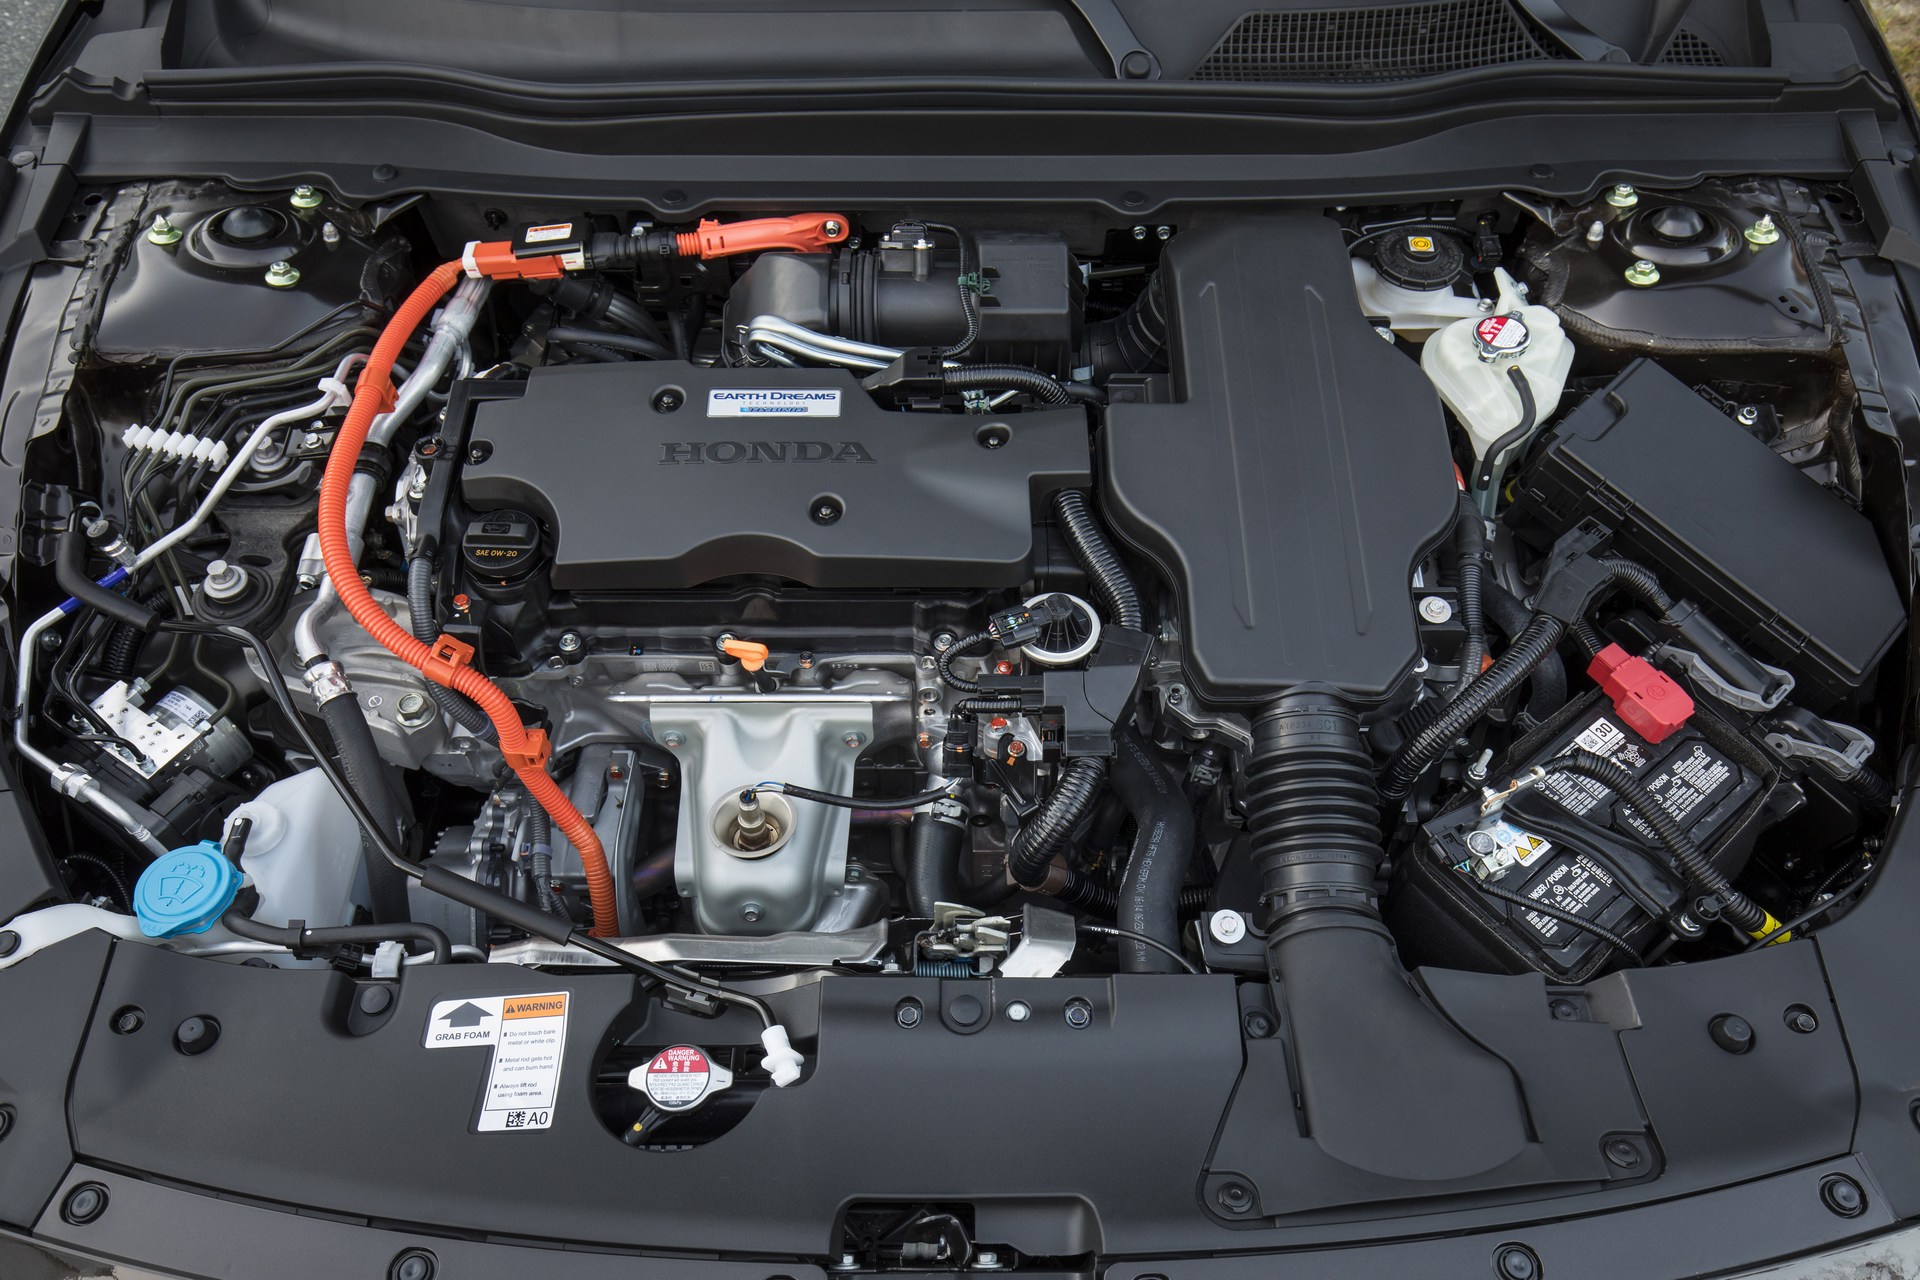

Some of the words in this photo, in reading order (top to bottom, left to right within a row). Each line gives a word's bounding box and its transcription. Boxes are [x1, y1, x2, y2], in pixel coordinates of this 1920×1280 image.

[713, 392, 767, 400] EARTH
[657, 441, 879, 465] HONDA
[1595, 722, 1613, 738] 3D
[516, 1001, 563, 1012] WARNING
[435, 1032, 462, 1041] GRAB
[463, 1031, 490, 1040] FOAM
[527, 1111, 548, 1125] A0
